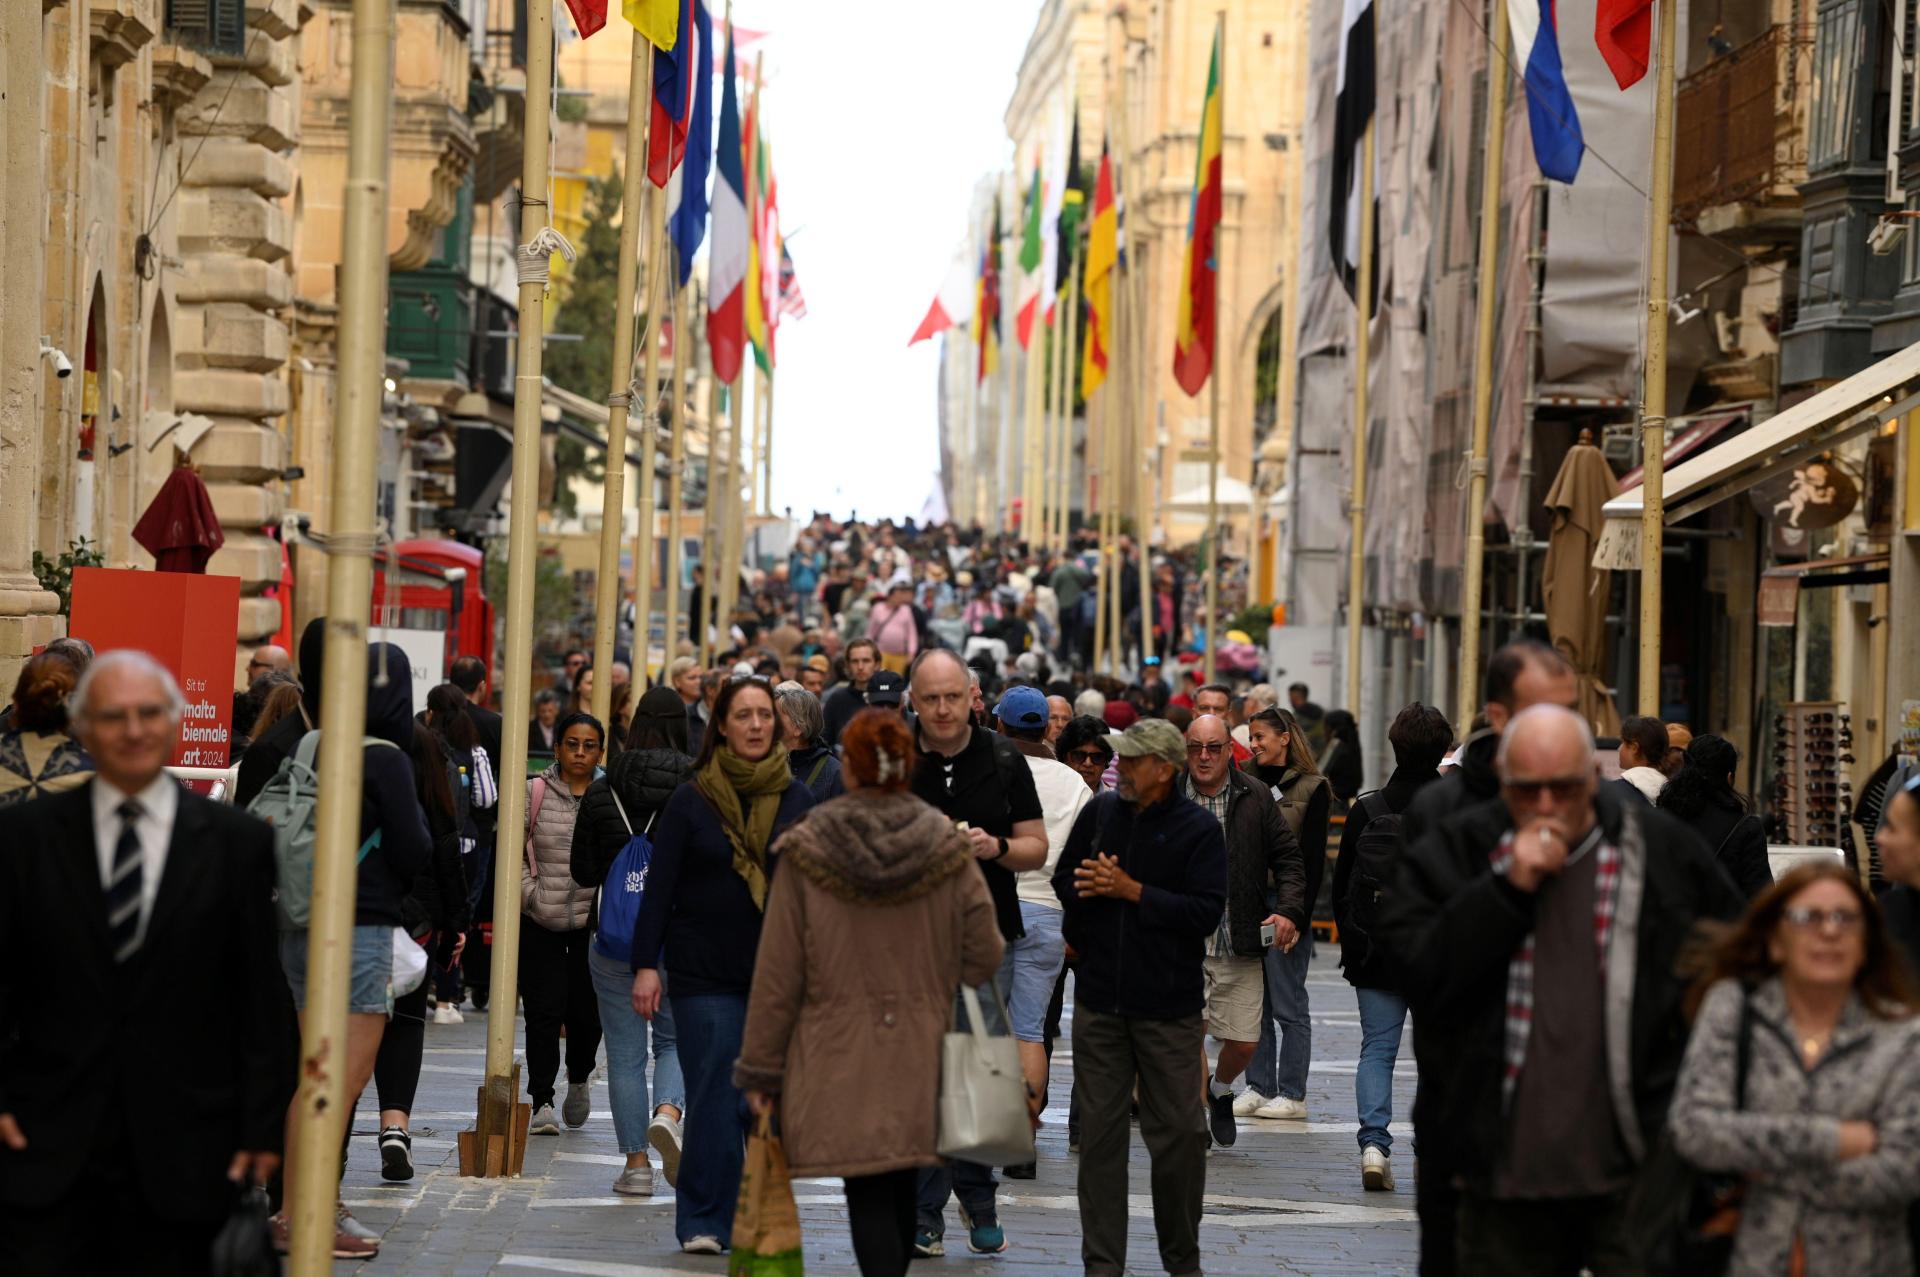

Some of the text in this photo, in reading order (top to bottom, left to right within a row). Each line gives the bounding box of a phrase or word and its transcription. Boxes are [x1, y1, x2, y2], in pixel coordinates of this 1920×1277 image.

[186, 679, 196, 691] Sit
[184, 699, 216, 719] malta
[182, 722, 228, 743] biennale
[180, 747, 224, 766] .art 2024
